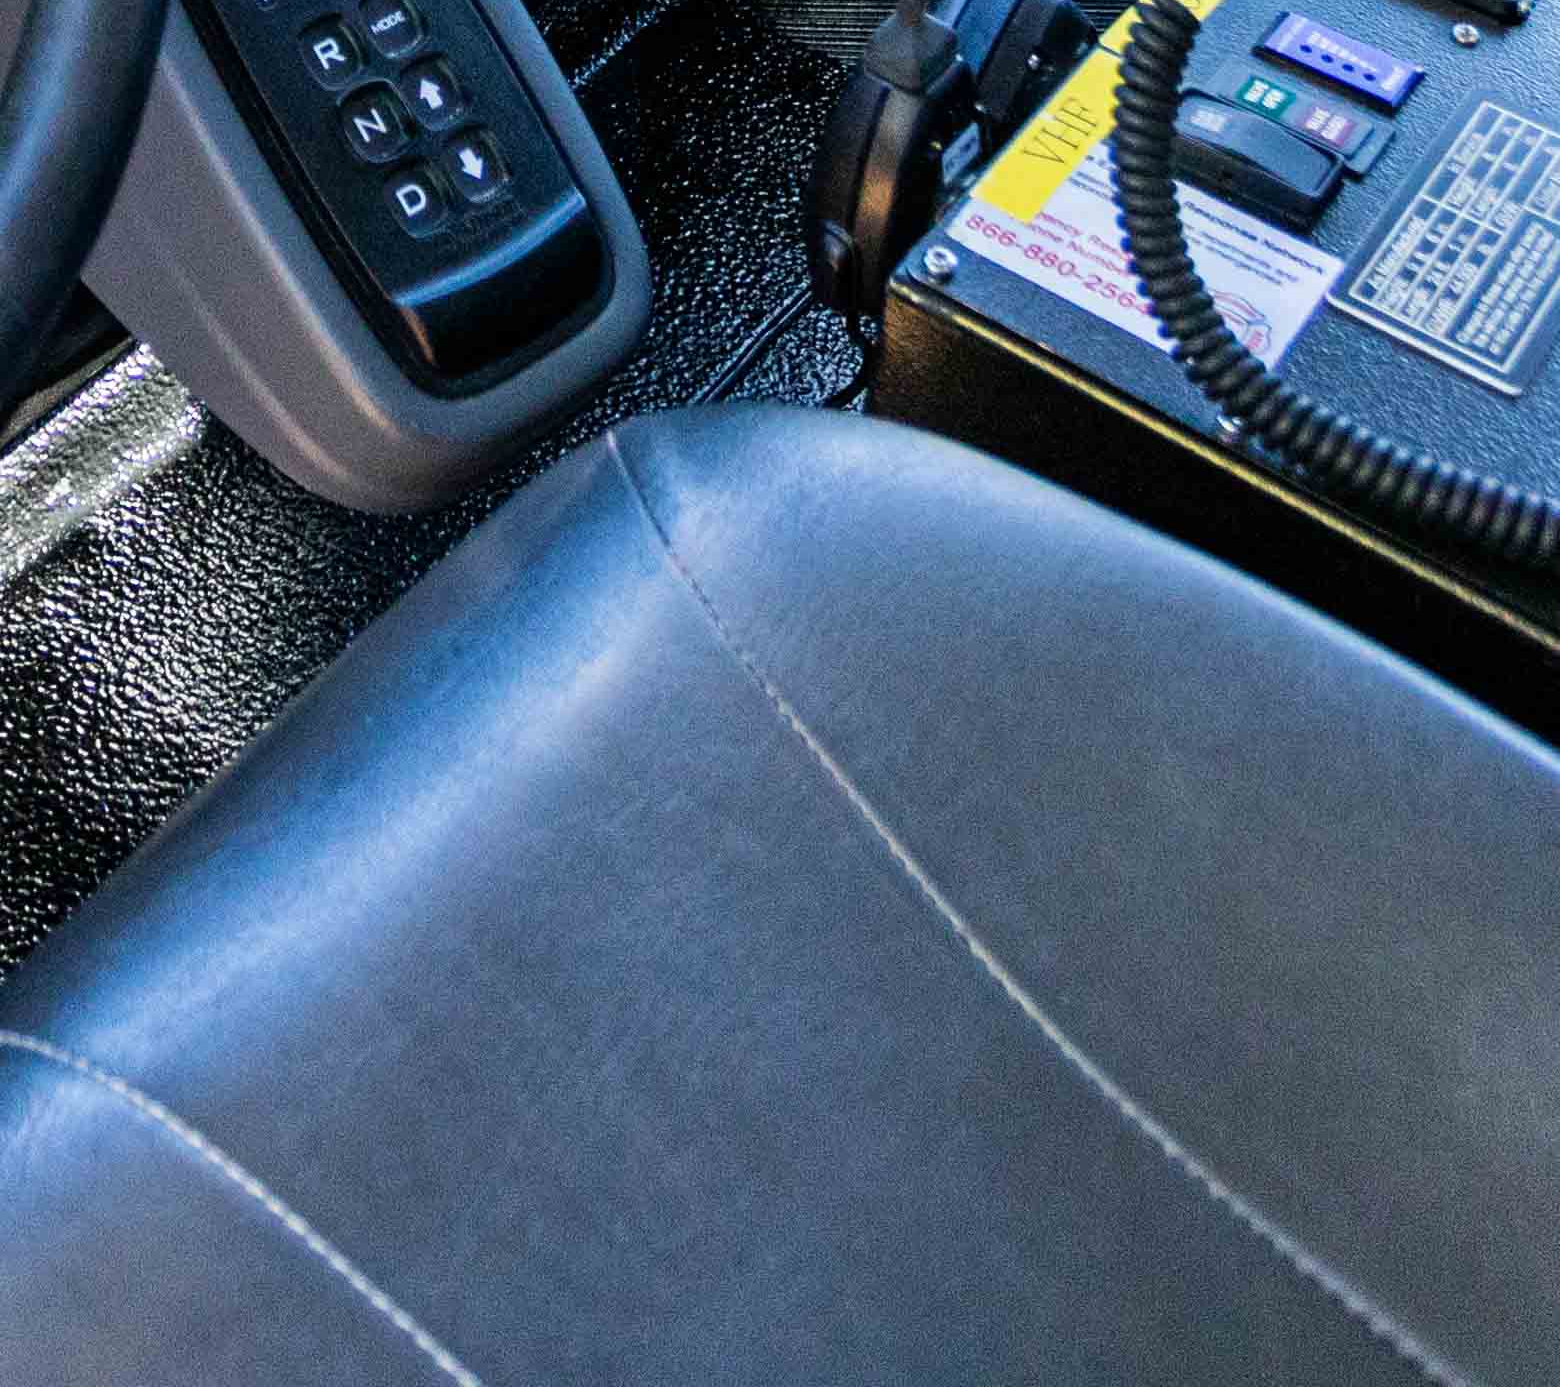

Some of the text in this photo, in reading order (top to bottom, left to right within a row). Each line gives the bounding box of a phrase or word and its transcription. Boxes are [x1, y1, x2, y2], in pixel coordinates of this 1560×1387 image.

[371, 9, 406, 35] MODE
[313, 37, 346, 71] R
[353, 108, 388, 142] N
[1022, 97, 1099, 165] VHF
[396, 182, 427, 217] D
